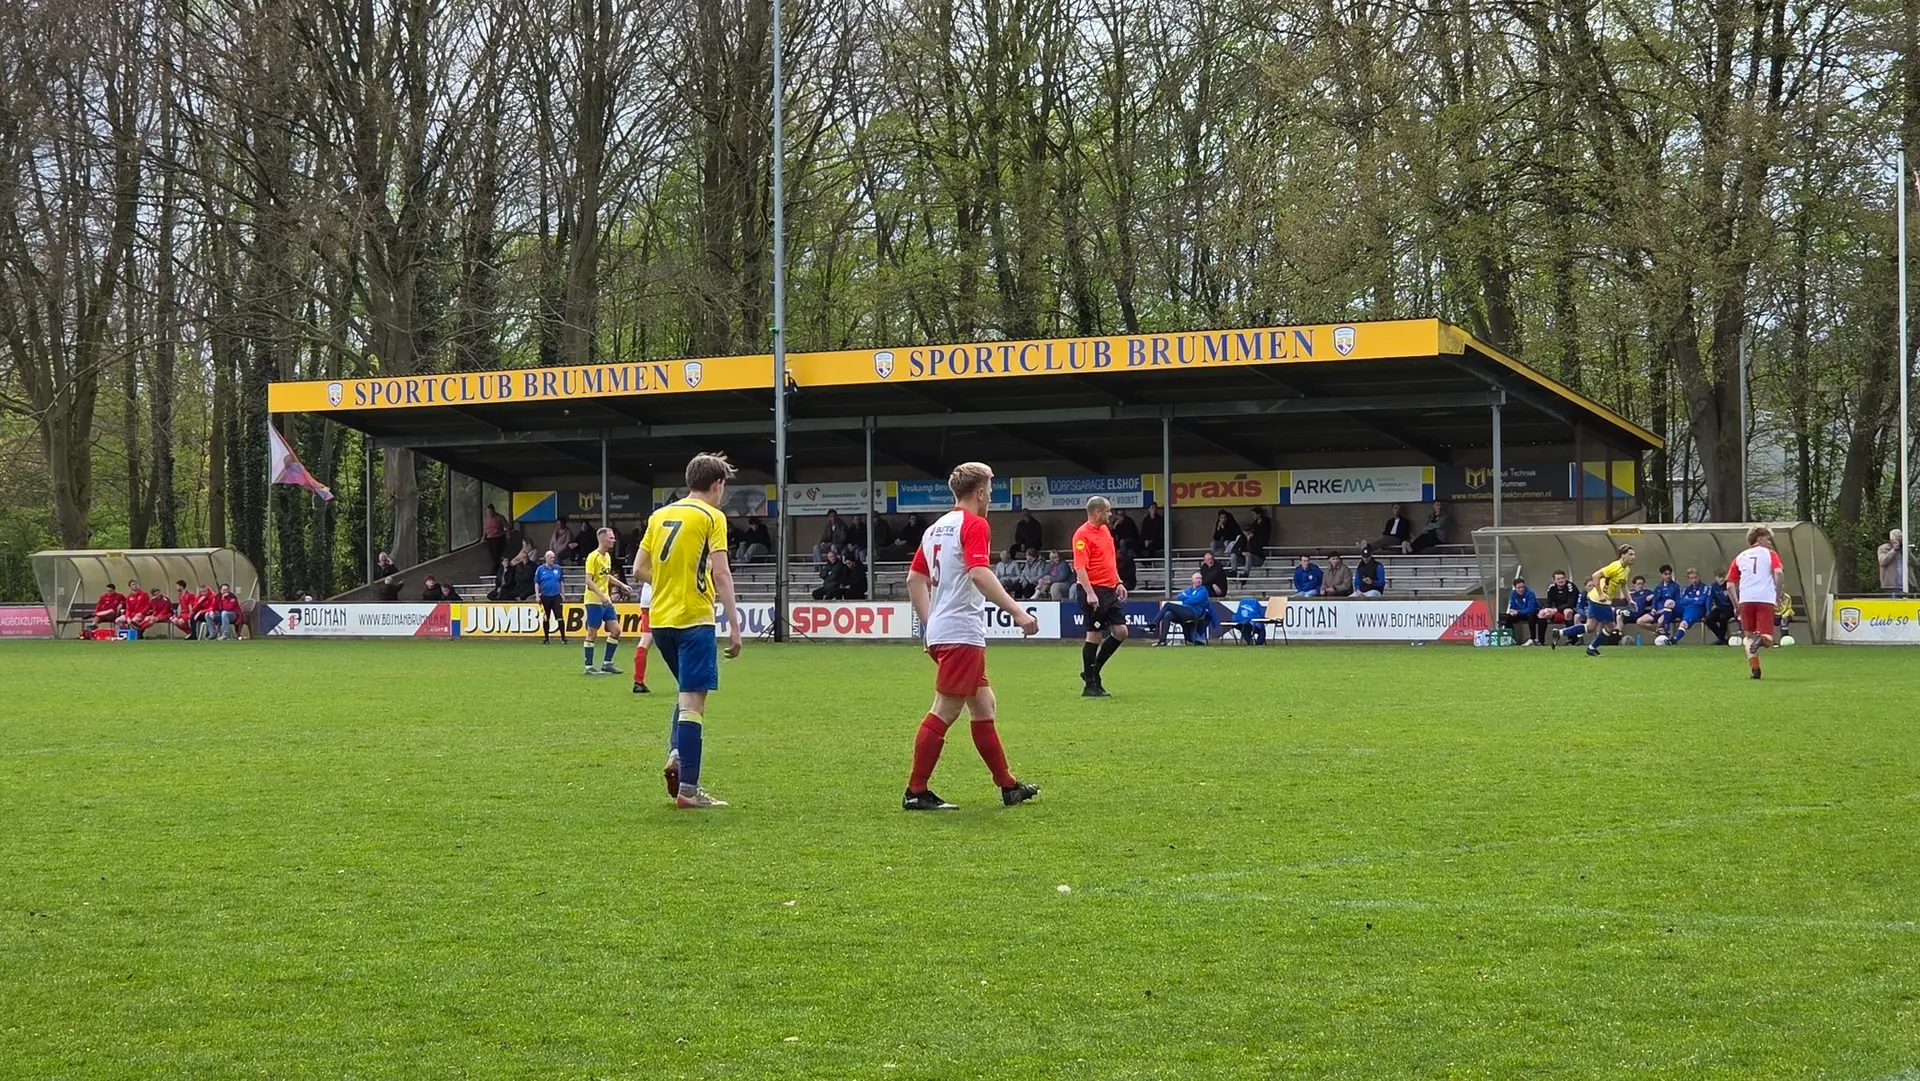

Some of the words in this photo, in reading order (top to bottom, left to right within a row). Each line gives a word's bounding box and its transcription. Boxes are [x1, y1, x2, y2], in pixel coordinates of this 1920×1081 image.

[909, 340, 1111, 377] SPORTCLUB
[1127, 329, 1314, 367] BRUMMEN
[355, 374, 512, 406] SPORTCLUB
[523, 364, 669, 398] BRUMMEN
[1510, 467, 1536, 477] Techniek
[901, 484, 934, 493] Voskamp
[1051, 481, 1106, 491] DORPSGARAGE
[1107, 478, 1140, 489] ELSHOF
[1171, 474, 1262, 505] praxis
[1294, 478, 1375, 494] ARKEMA
[660, 520, 683, 562] 7
[932, 543, 942, 588] 5
[1749, 556, 1758, 574] 7
[304, 607, 347, 626] BOSMAN
[792, 606, 894, 634] SPORT
[1285, 605, 1338, 629] OSMAN
[1355, 612, 1489, 628] WWW.BOSMANBRUMMEN.NL
[1896, 616, 1909, 626] 50
